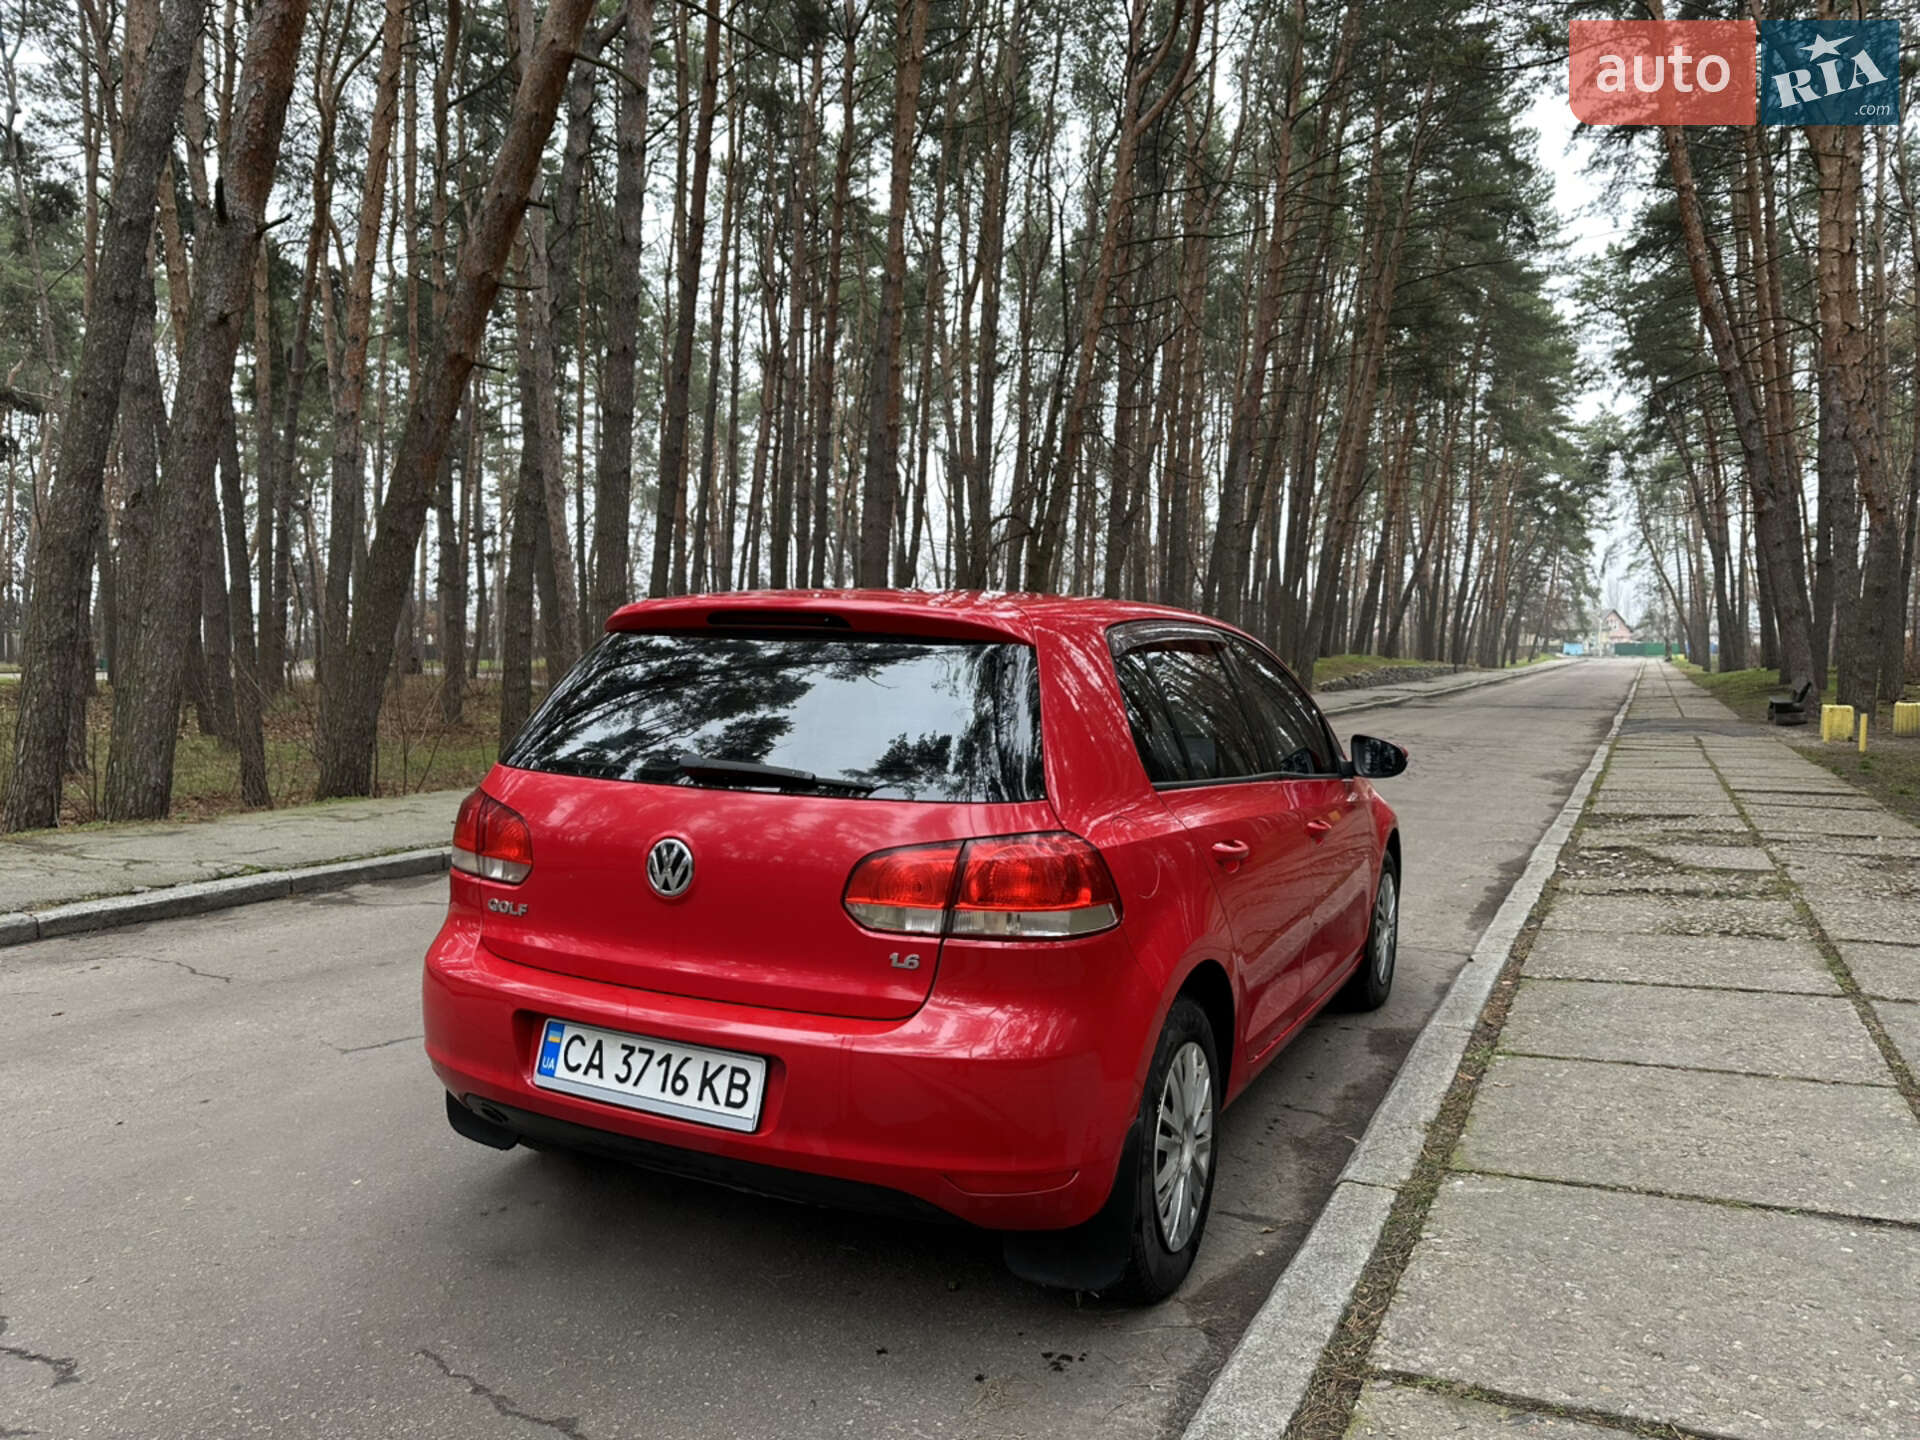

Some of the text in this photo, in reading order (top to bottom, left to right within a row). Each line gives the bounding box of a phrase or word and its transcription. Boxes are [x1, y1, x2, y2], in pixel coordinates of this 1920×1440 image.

[648, 840, 693, 895] VW
[487, 898, 529, 916] GOLF
[889, 952, 921, 970] 1.6
[541, 1056, 555, 1071] UA
[563, 1034, 752, 1110] CA 3716 KB
